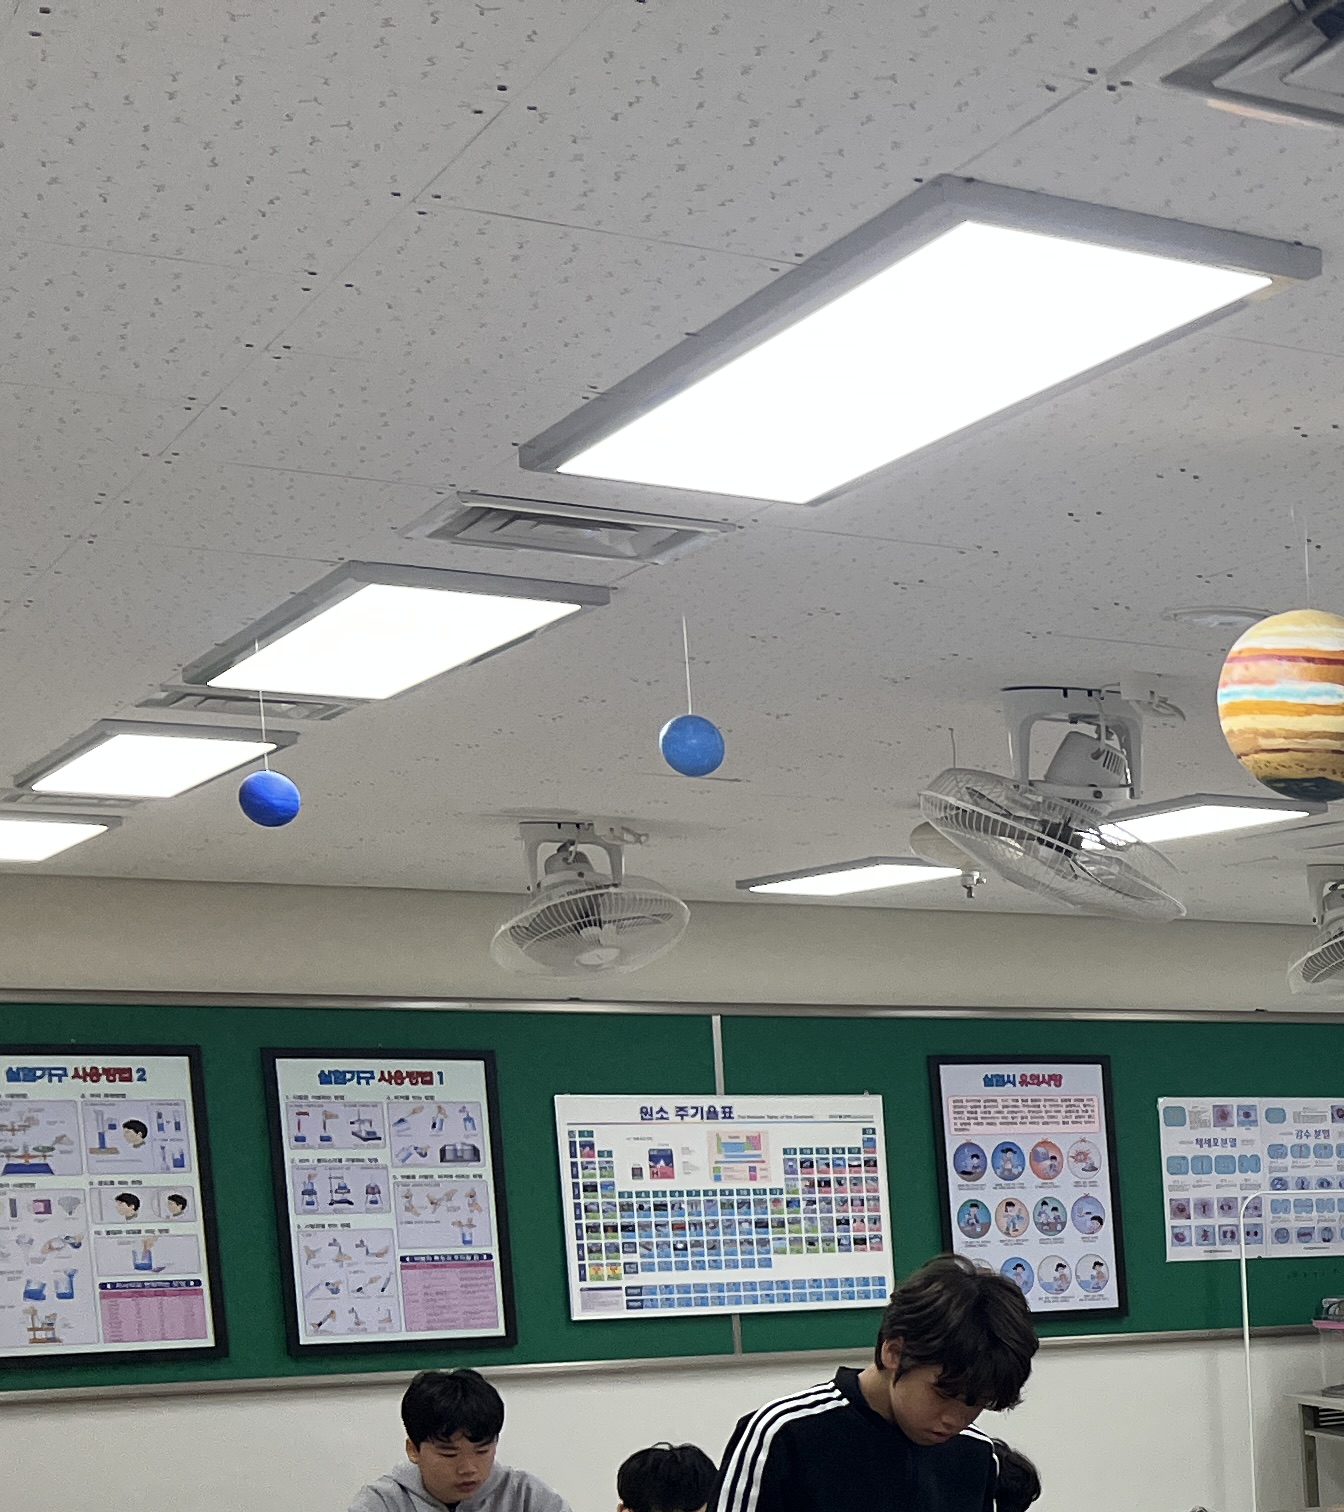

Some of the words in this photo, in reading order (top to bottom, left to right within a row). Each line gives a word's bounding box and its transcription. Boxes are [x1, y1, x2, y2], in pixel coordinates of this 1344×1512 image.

[136, 1067, 147, 1082] 2
[436, 1071, 444, 1085] 1
[640, 1105, 670, 1121] 원소
[674, 1105, 735, 1121] 주기율표
